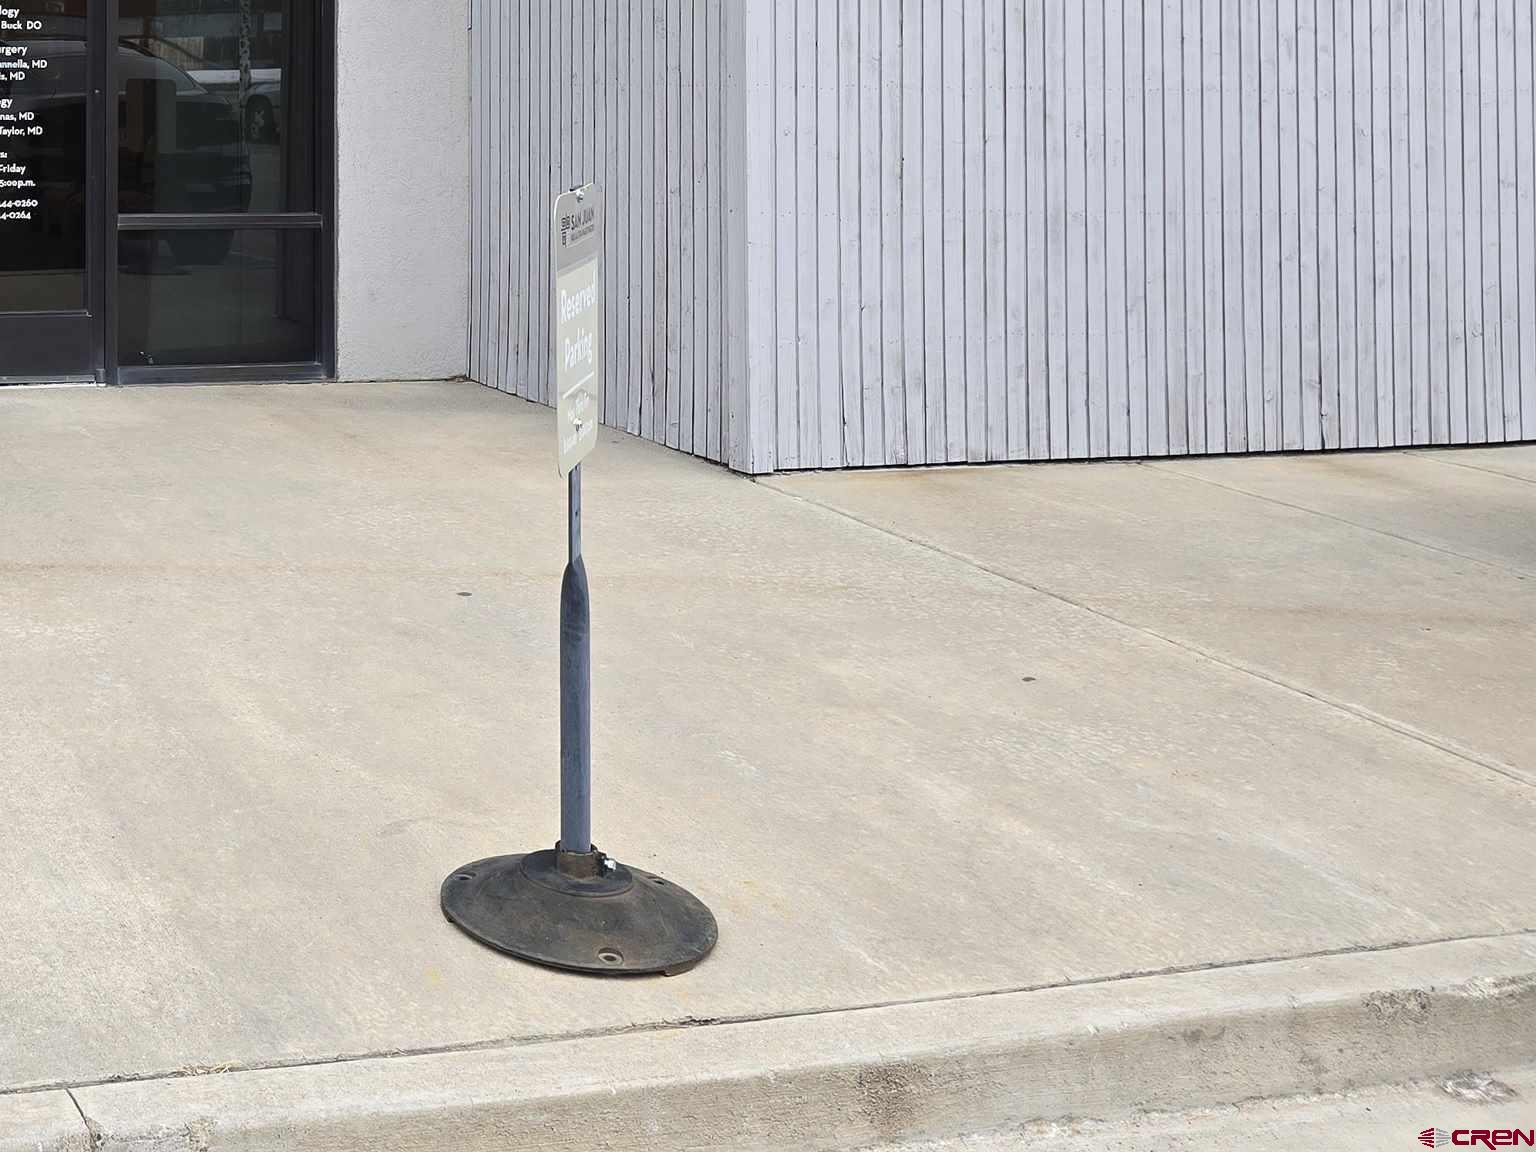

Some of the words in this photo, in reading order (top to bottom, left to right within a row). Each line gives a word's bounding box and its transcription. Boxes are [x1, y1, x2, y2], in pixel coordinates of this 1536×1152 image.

[1, 20, 23, 30] Buck
[26, 20, 42, 30] DO
[32, 59, 48, 69] MD
[9, 71, 26, 80] MD
[18, 112, 35, 121] MD
[27, 126, 43, 135] MD
